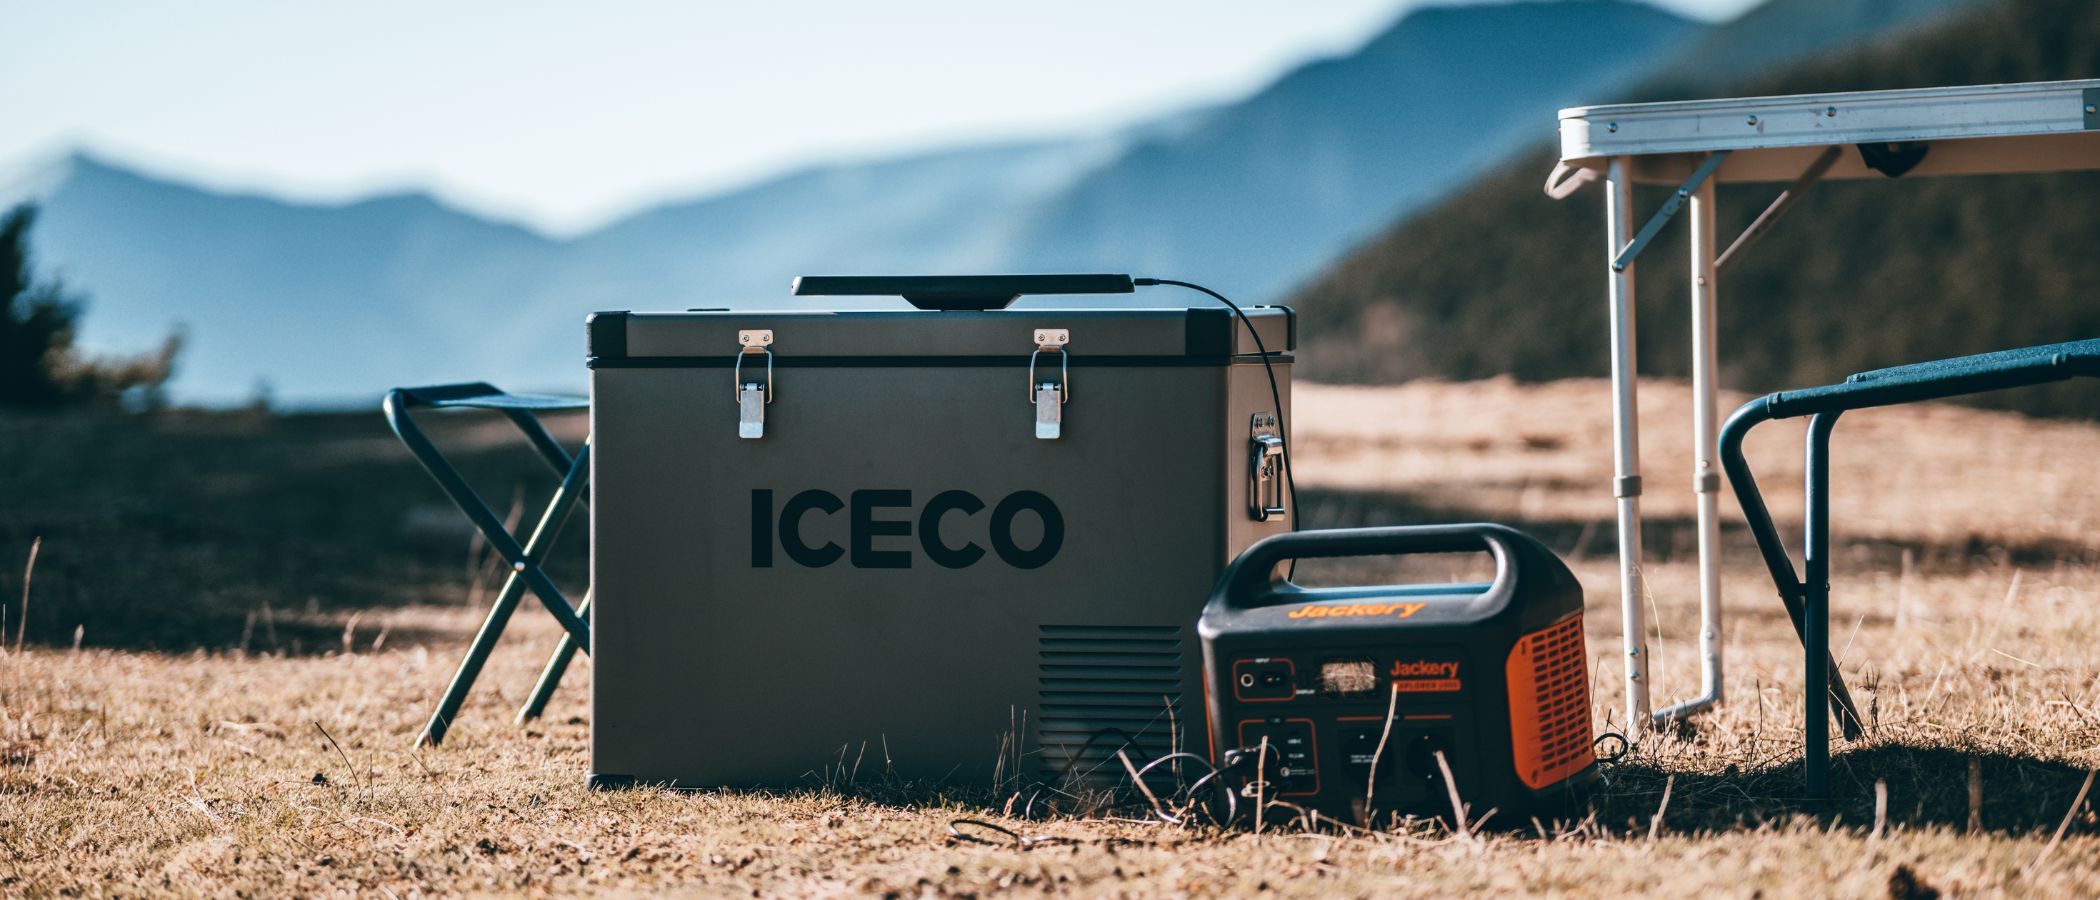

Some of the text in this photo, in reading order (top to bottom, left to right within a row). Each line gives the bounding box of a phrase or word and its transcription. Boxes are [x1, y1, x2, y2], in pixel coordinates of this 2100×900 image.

[751, 488, 1065, 570] ICECO
[1288, 602, 1425, 619] Jackery
[1391, 660, 1459, 679] Jackery
